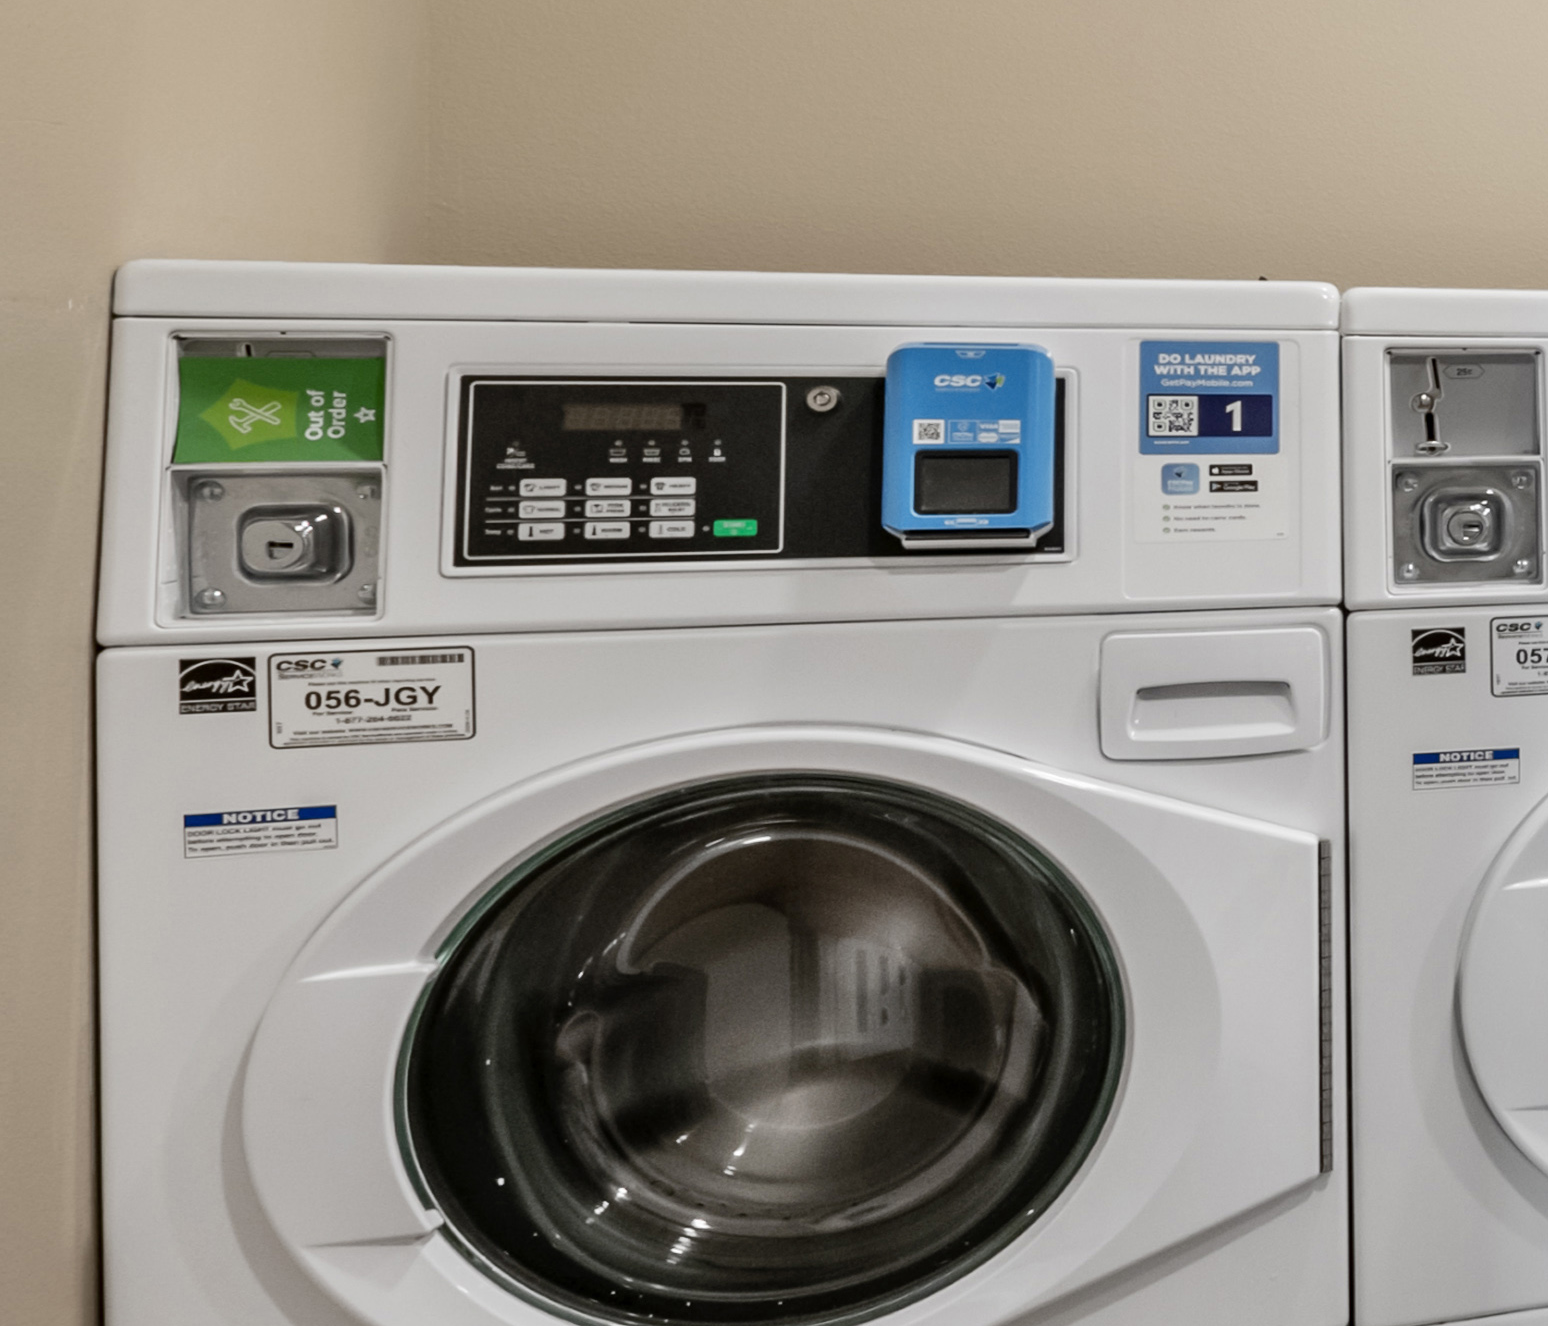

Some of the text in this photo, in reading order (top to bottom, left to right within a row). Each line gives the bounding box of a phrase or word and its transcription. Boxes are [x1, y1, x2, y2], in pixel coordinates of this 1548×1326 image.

[1158, 354, 1256, 364] DO LAUNDRY
[1154, 365, 1261, 375] WITH THE APP
[934, 375, 982, 387] CSC
[1161, 378, 1253, 388] GetPayMobile.com
[305, 389, 325, 441] Out of
[327, 391, 346, 438] Order
[1226, 401, 1242, 431] 1
[1496, 623, 1531, 632] CSC
[276, 659, 327, 672] CSC
[305, 686, 441, 710] 056-JGY
[181, 702, 256, 713] ENERGY STAR
[1440, 751, 1493, 762] NOTICE
[223, 809, 299, 824] NOTICE
